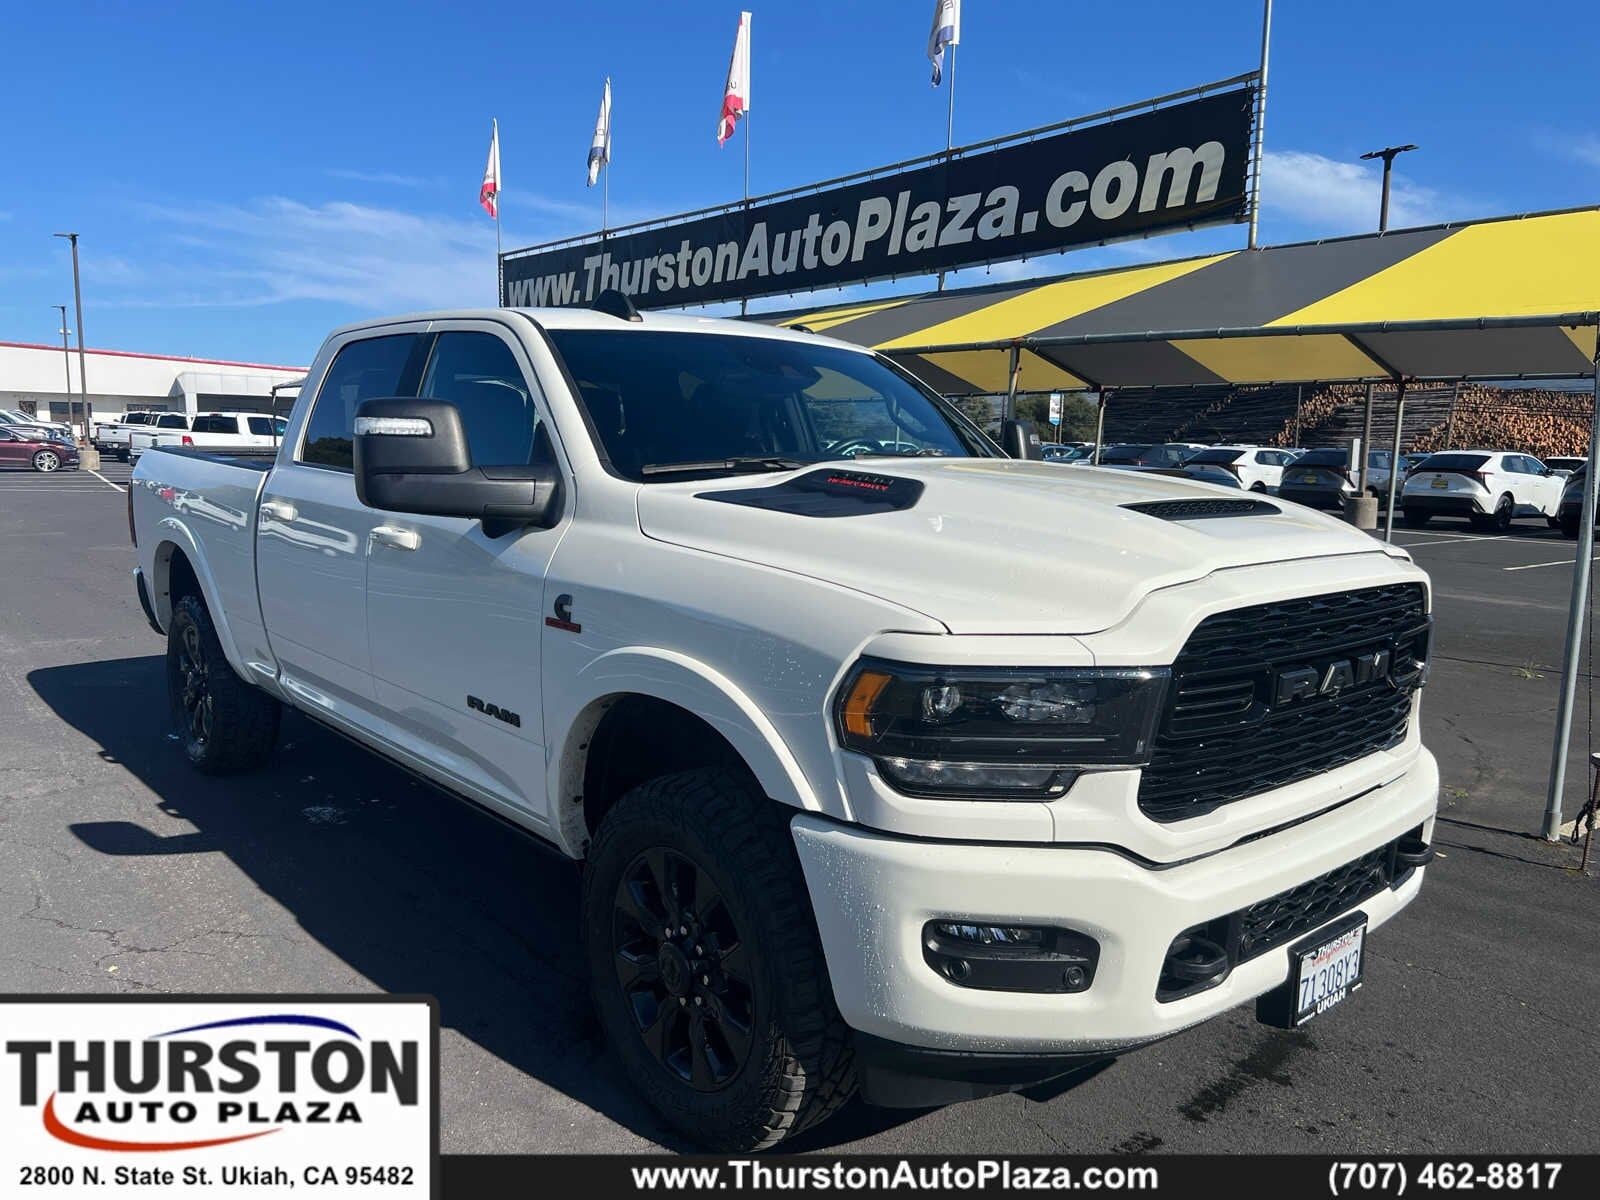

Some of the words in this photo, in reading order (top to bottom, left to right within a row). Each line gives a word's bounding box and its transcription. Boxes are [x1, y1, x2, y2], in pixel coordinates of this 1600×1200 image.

[508, 137, 1225, 308] www.ThurstonAutoPlaza.com
[1276, 650, 1391, 705] RAM
[466, 694, 521, 728] RAM
[1300, 949, 1360, 1010] 71308Y3
[1316, 987, 1347, 1014] UKIAH
